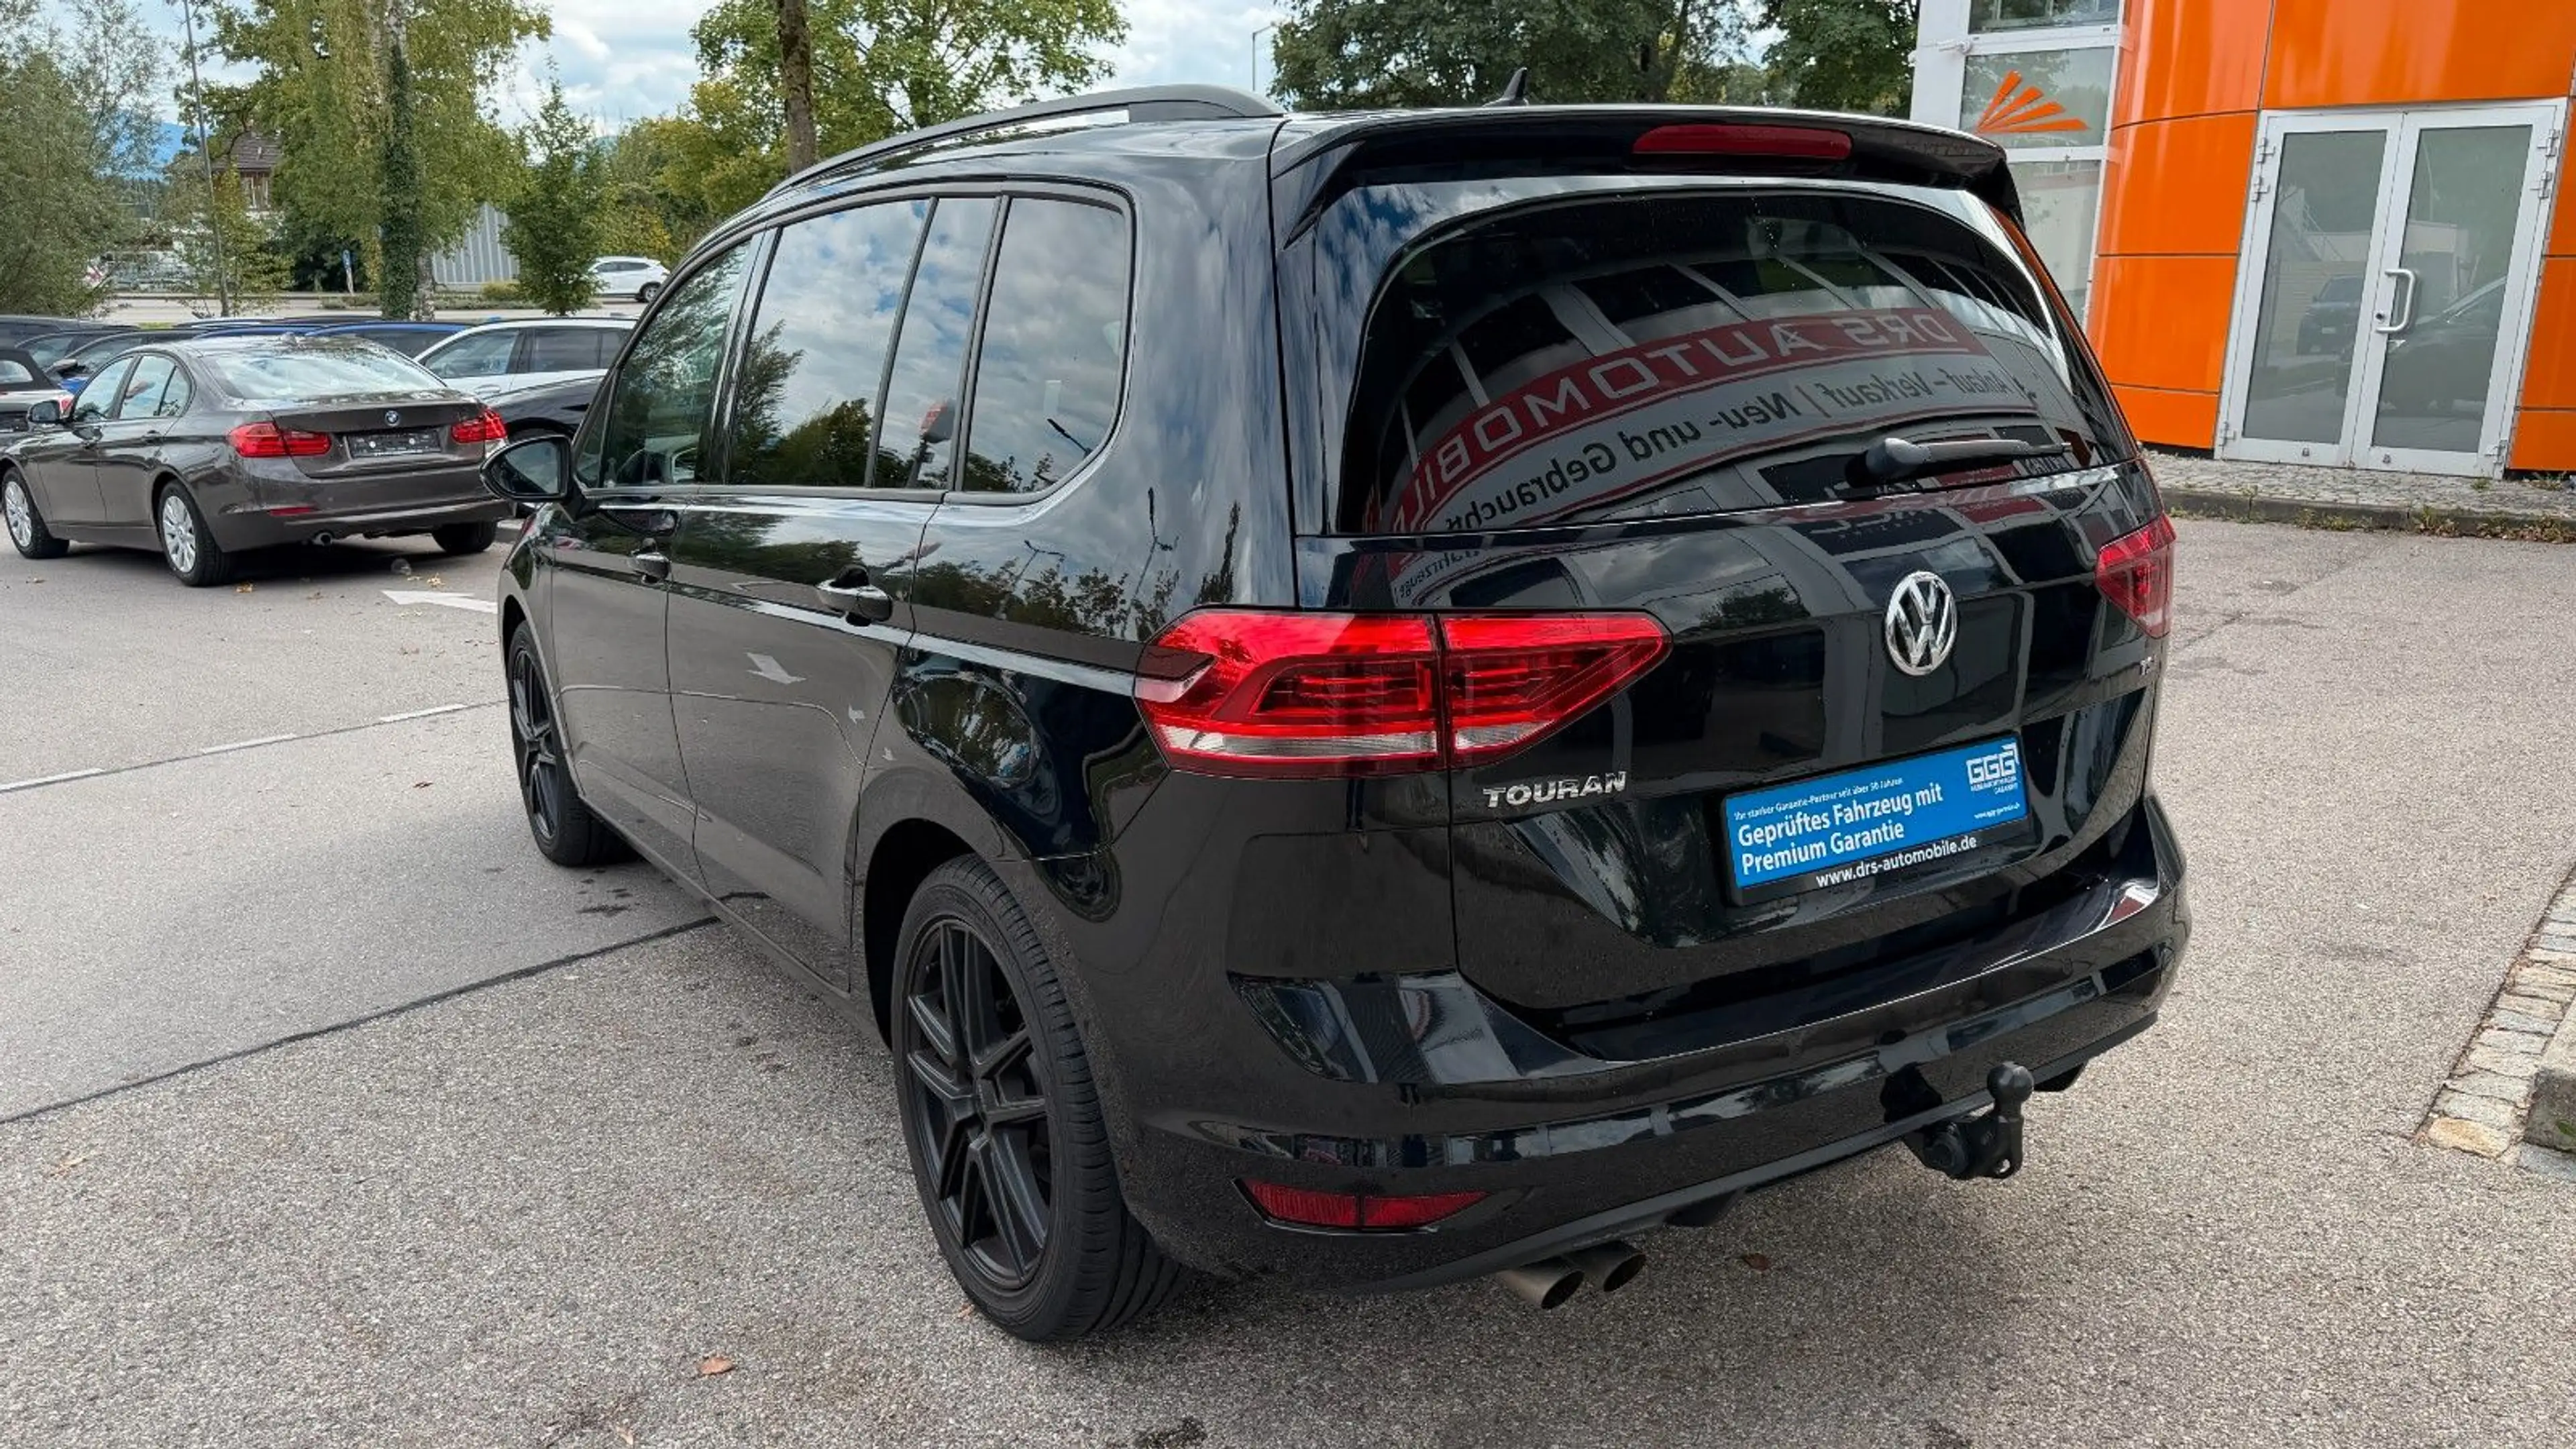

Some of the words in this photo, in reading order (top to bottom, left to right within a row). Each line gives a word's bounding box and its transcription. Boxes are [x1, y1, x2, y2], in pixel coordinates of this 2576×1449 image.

[1483, 771, 1627, 808] TOURAN
[1966, 745, 2018, 784] GGG
[1738, 811, 1831, 848] Geprüftes
[1832, 793, 1913, 826] Fahrzeug
[1915, 782, 1943, 807] mit
[1741, 840, 1827, 875] Premium
[1830, 819, 1904, 854] Garantie
[1815, 835, 1977, 888] www.drs-automobile.de
